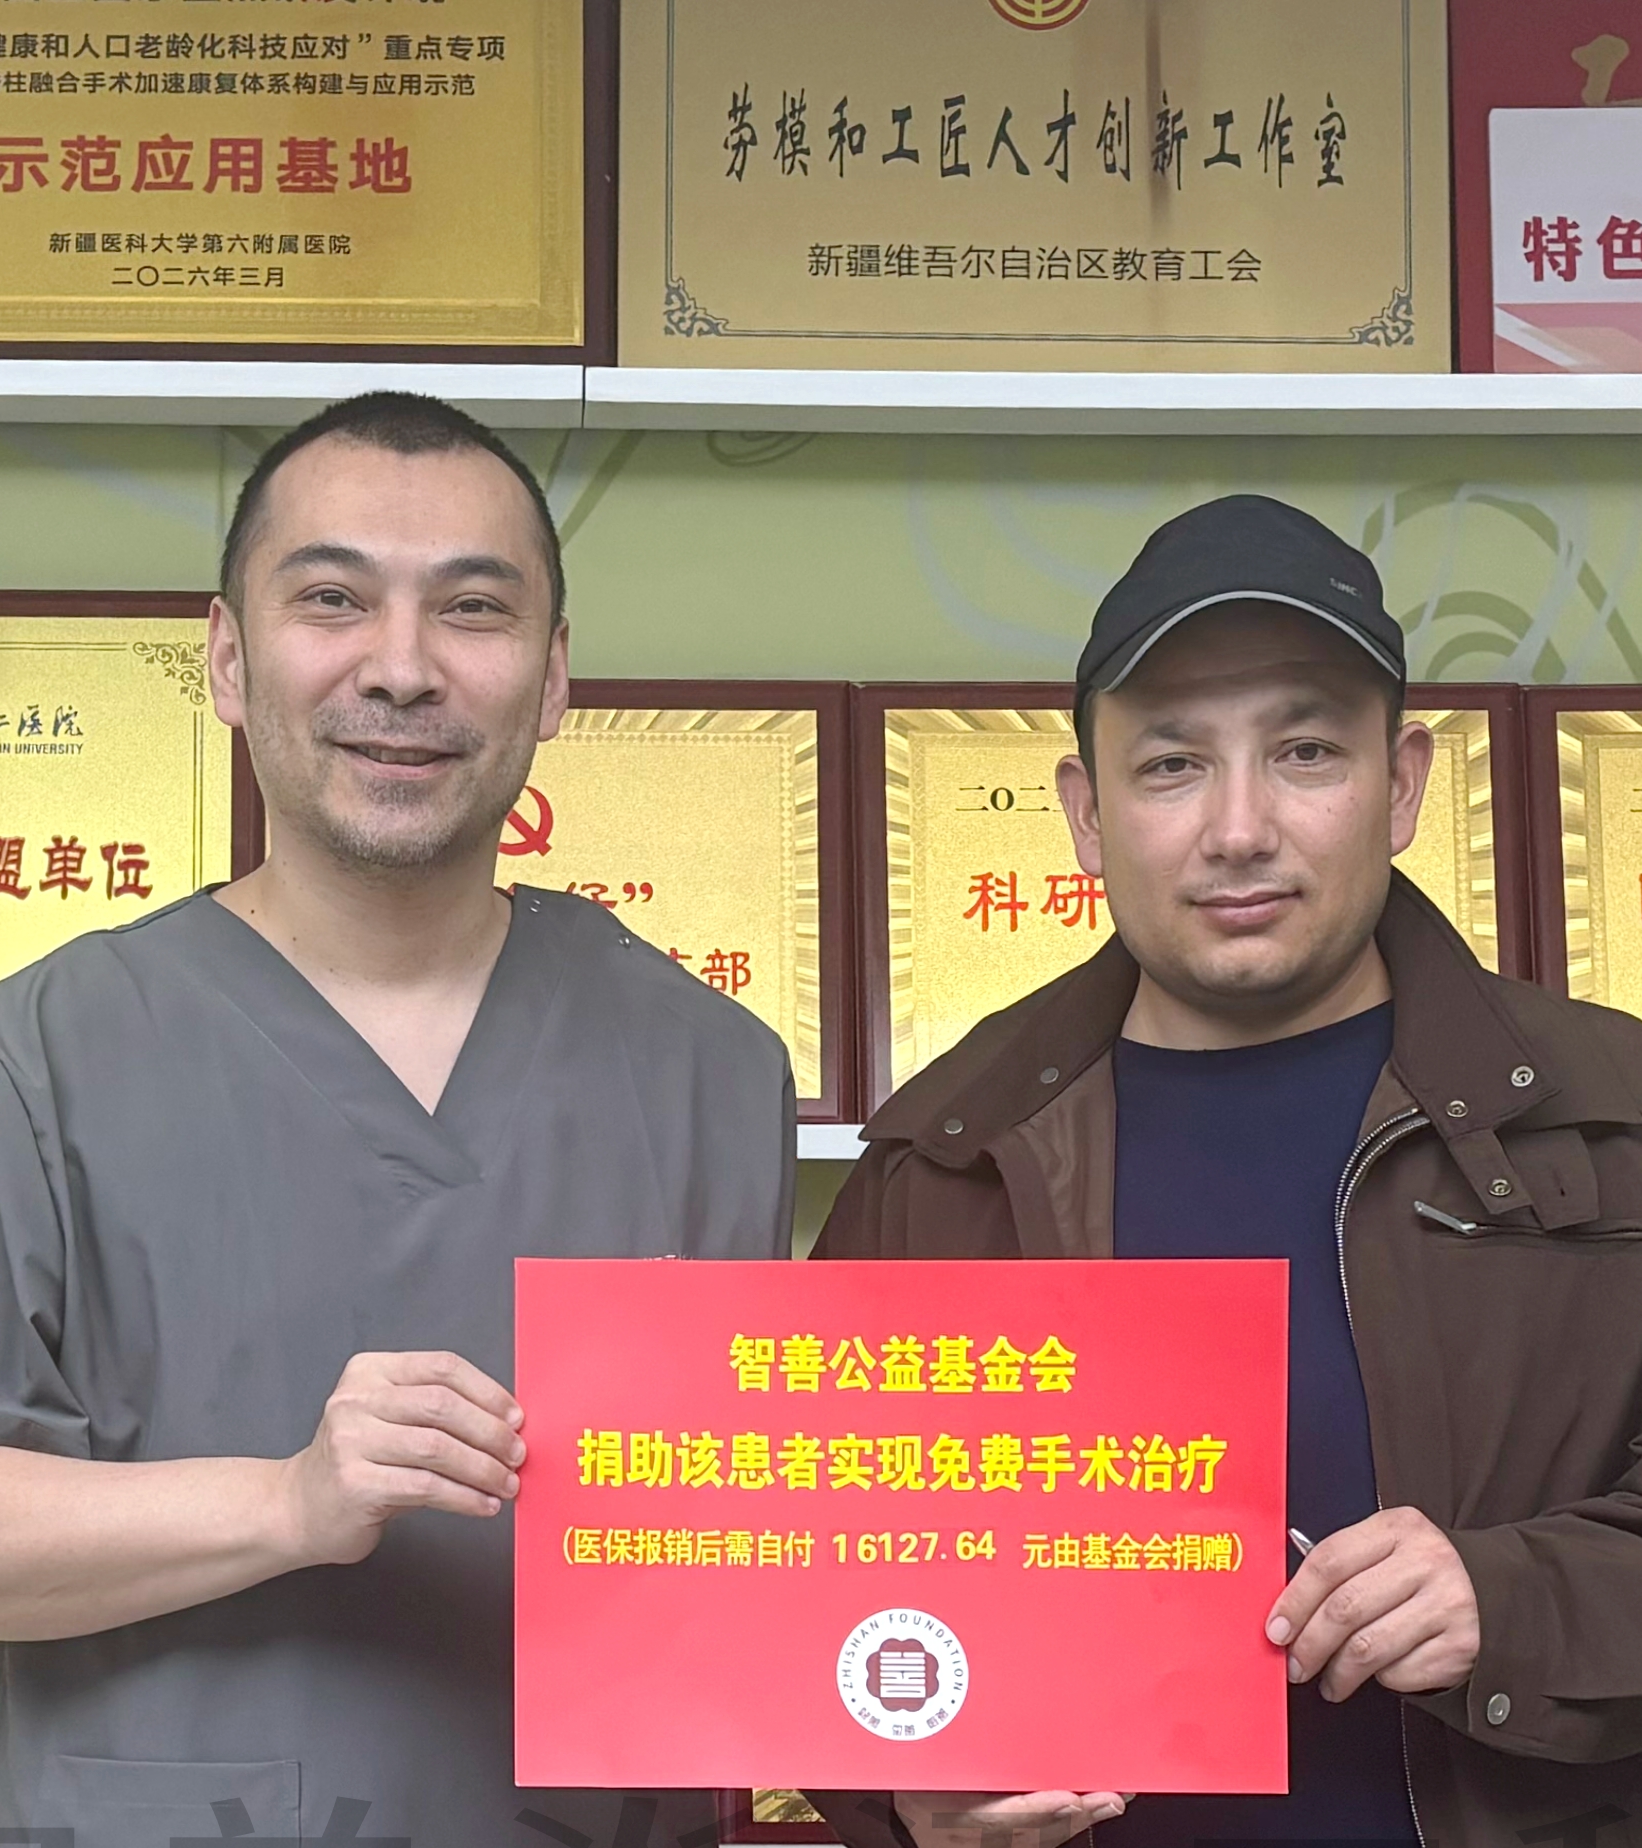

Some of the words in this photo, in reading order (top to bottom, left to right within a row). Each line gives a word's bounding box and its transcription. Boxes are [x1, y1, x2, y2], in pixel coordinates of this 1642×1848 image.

[722, 82, 1350, 190] 劳模和工匠人才创新工作室
[48, 232, 353, 256] 新疆医科大学第六附属医院
[807, 242, 1263, 285] 新疆维吾尔自治区教育工会
[14, 743, 84, 755] UNIVERSITY
[729, 1334, 1077, 1395] 智善公益基金会
[577, 1428, 1228, 1494] 捐助该患者实现免费手术治疗
